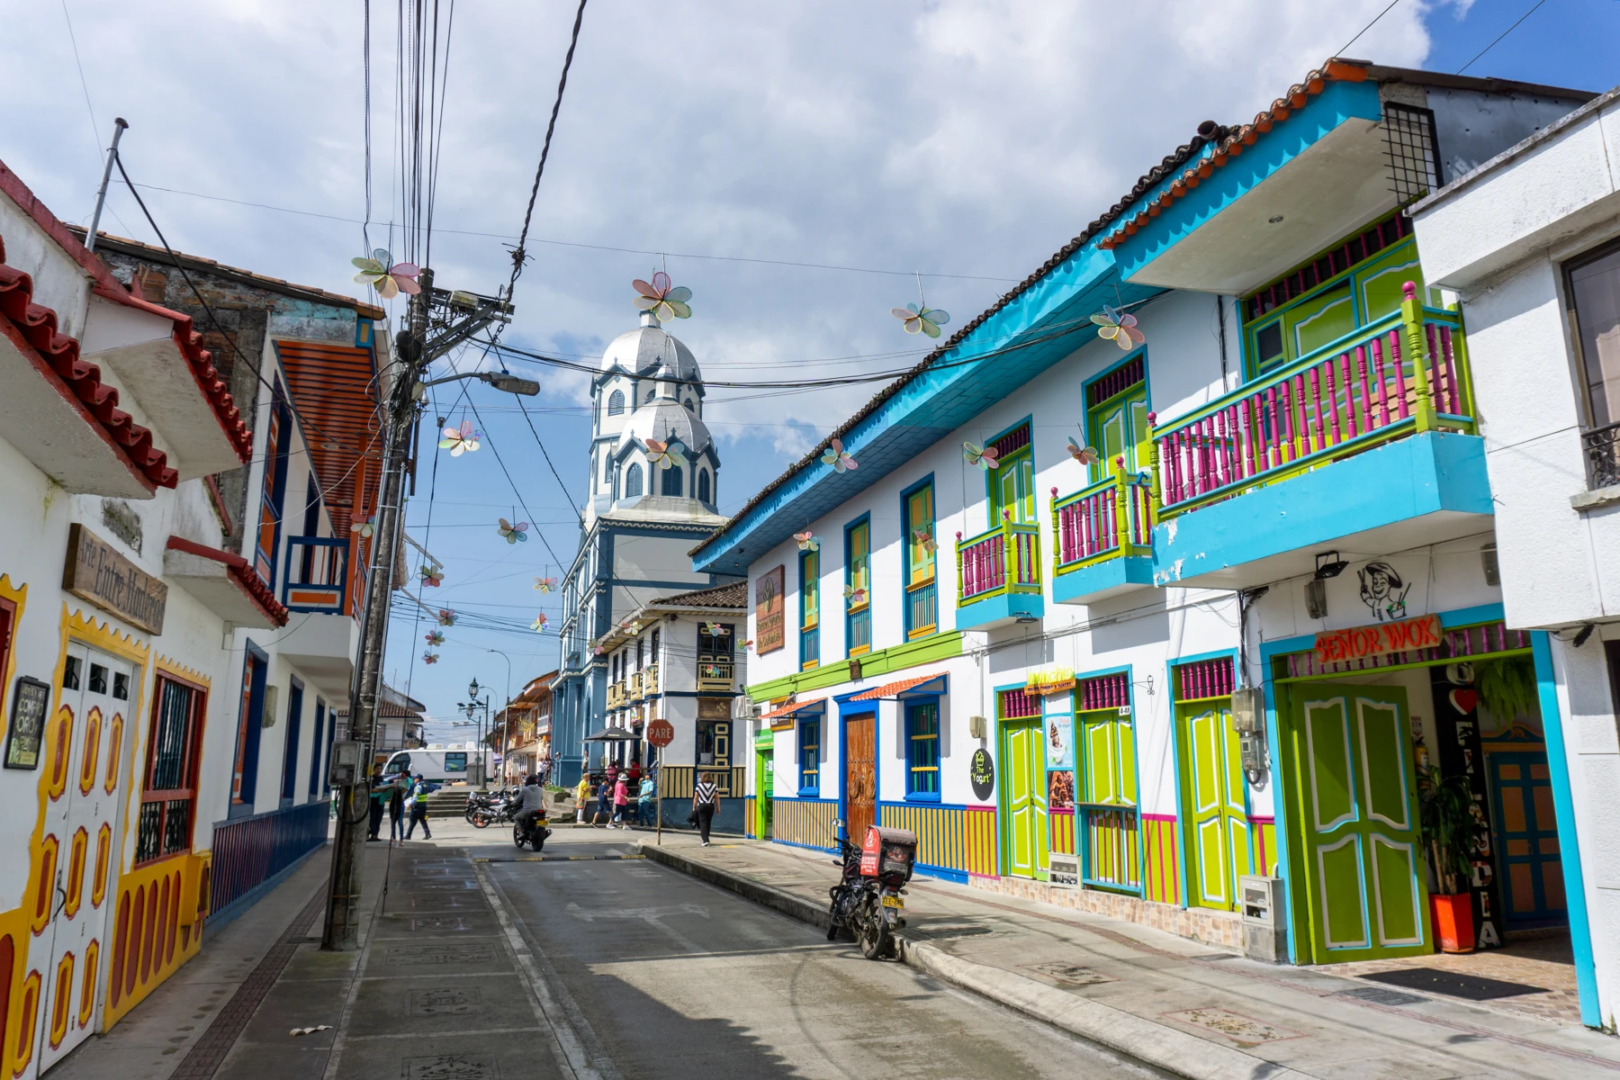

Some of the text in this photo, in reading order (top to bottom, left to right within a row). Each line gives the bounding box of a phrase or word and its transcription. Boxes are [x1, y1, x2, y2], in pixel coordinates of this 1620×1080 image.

[94, 546, 124, 608] Entre
[1314, 617, 1438, 662] SEÑOR WOK
[649, 728, 672, 739] PARE
[976, 766, 984, 774] The
